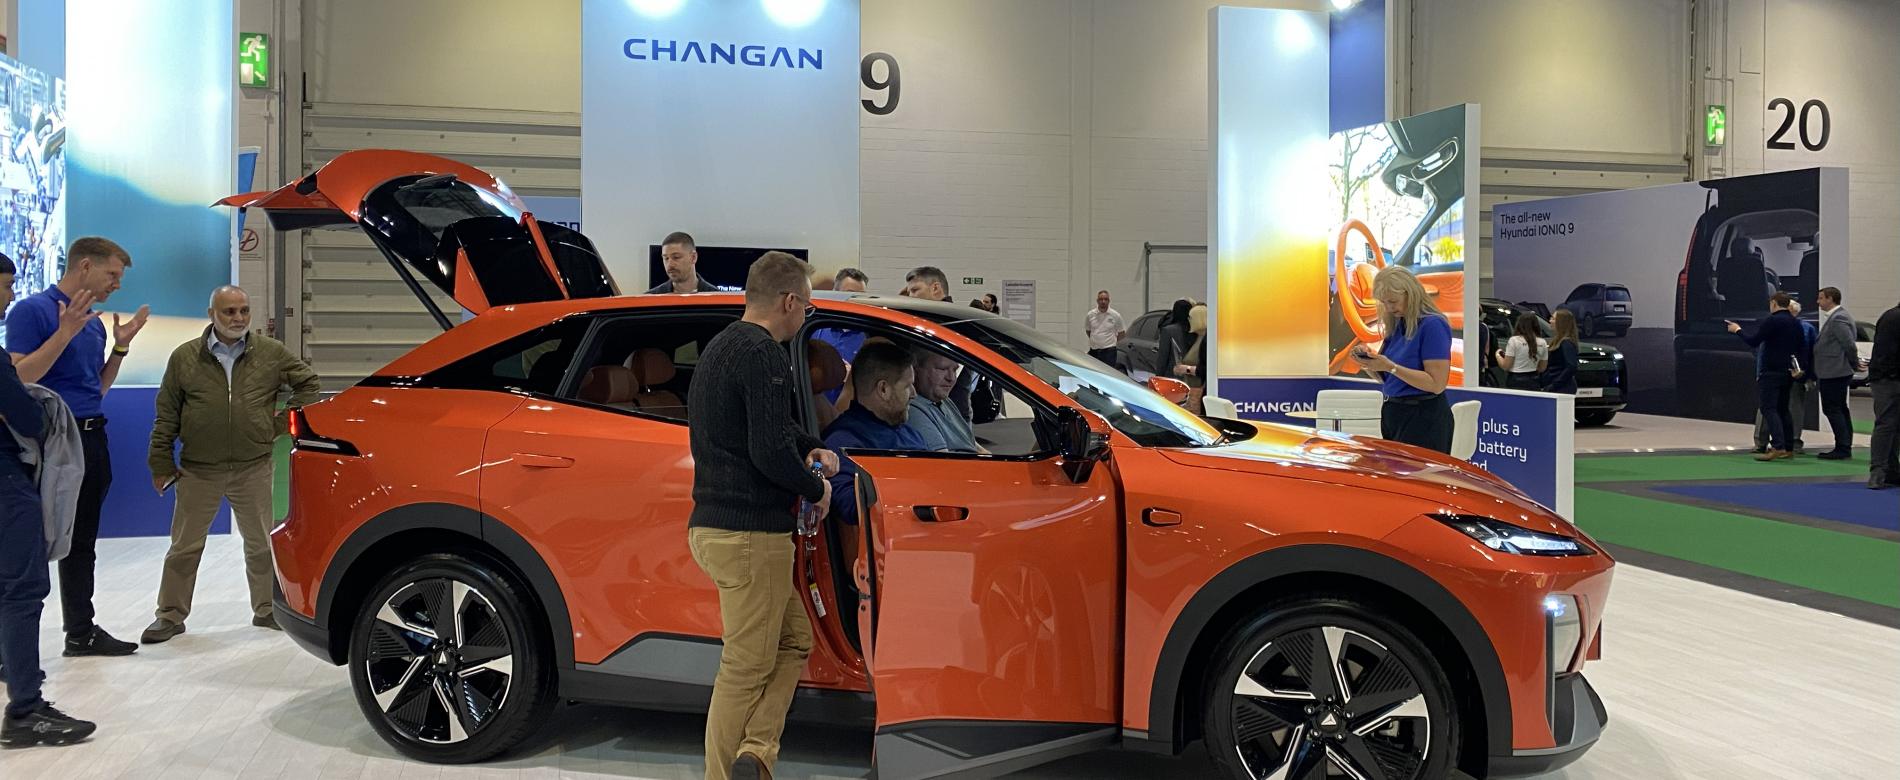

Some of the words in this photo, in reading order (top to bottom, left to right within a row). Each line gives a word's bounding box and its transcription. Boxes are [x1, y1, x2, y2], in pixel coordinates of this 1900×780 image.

[623, 38, 823, 70] CHANGAN
[1767, 97, 1831, 152] 20
[1500, 214, 1516, 225] The
[1517, 211, 1551, 224] all-new
[1500, 225, 1537, 240] Hyundai
[1538, 223, 1566, 236] IONIQ
[1567, 222, 1575, 234] 9
[1234, 402, 1314, 413] CHANGAN
[1482, 418, 1509, 435] plus
[1512, 424, 1520, 436] a
[1479, 438, 1527, 462] battery
